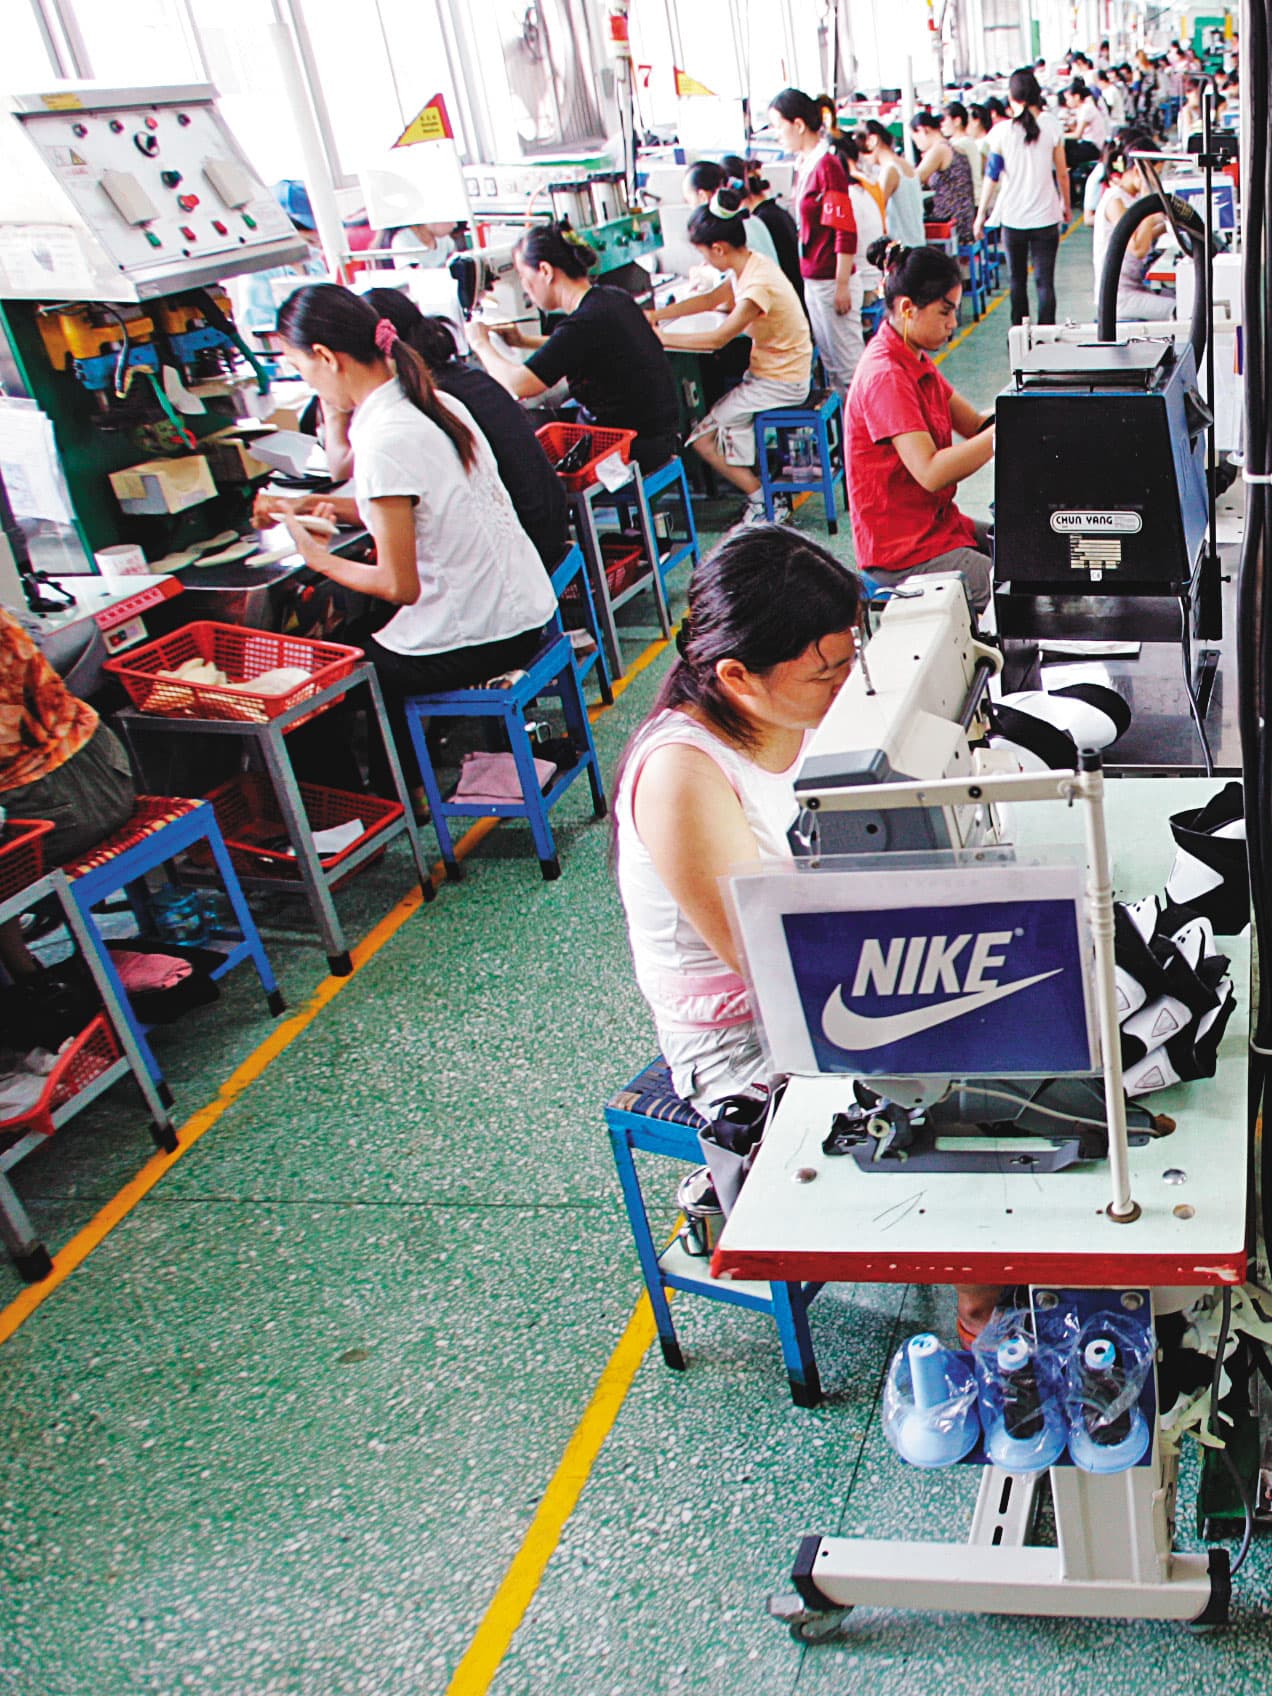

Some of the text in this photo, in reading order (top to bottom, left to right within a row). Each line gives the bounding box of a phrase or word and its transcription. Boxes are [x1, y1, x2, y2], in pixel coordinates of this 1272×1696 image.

[638, 64, 652, 88] 7
[1056, 516, 1082, 525] CHUN
[852, 931, 1014, 997] NIKE
